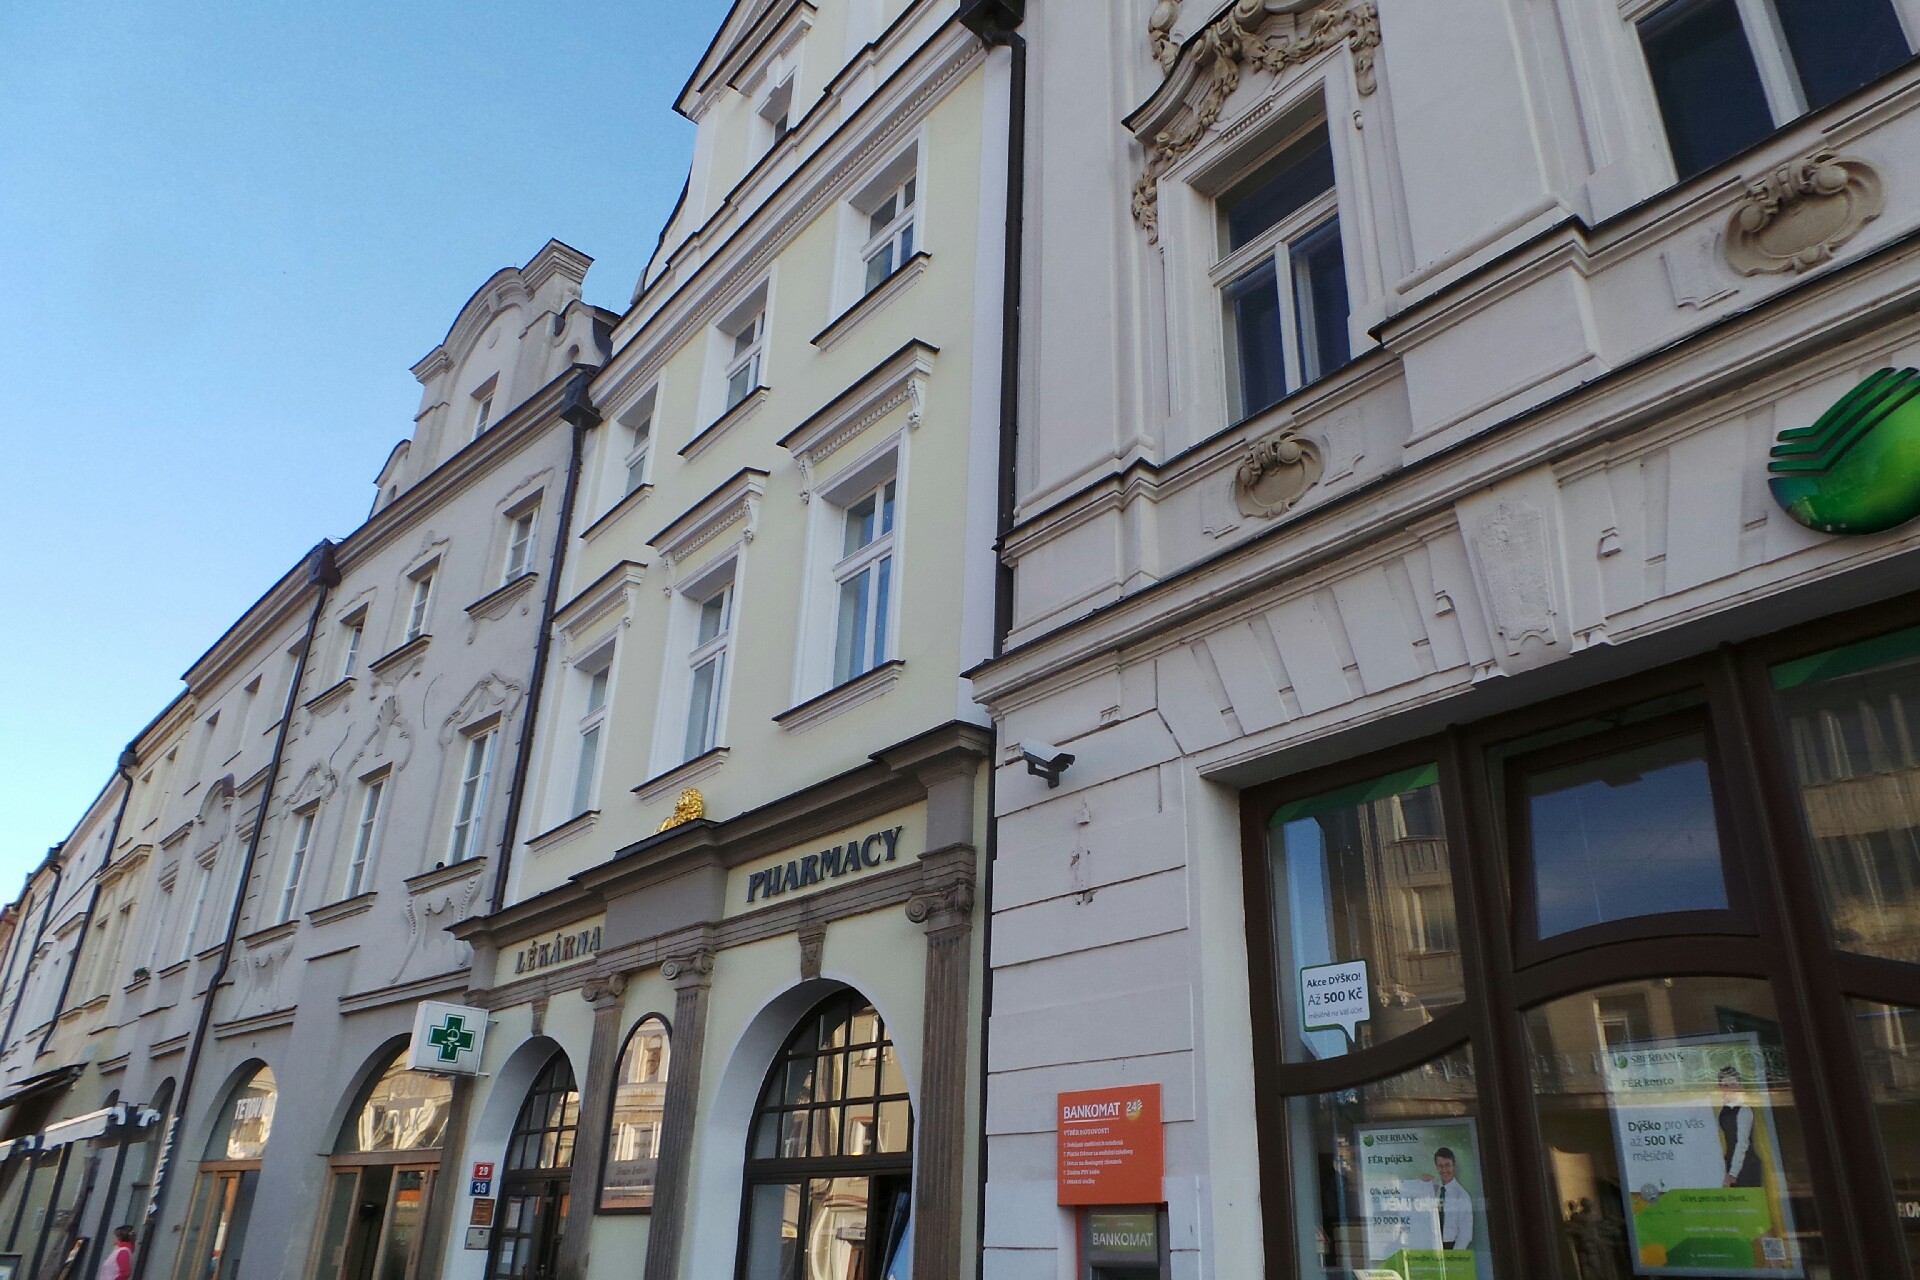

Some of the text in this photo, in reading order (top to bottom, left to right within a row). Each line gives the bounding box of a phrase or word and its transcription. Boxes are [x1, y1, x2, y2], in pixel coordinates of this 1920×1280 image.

[747, 825, 902, 903] PHARMACY
[514, 925, 601, 974] LÉKÁRNA
[1307, 972, 1361, 988] Akce DÝŠKO!
[1308, 986, 1363, 1006] Až 500 Kč
[1630, 1051, 1684, 1063] SBERBANK
[1063, 1102, 1121, 1120] BANKOMAT
[1628, 1118, 1705, 1134] Dýško pro Vás
[1376, 1133, 1418, 1142] SBERBANK
[1630, 1134, 1684, 1147] až 500 Kč
[1367, 1154, 1413, 1165] FÉR půjčka
[478, 1166, 489, 1176] 29
[474, 1182, 487, 1194] 39
[1383, 1216, 1399, 1225] 000
[1400, 1216, 1411, 1225] Kč
[1092, 1232, 1154, 1247] BANKOMAT
